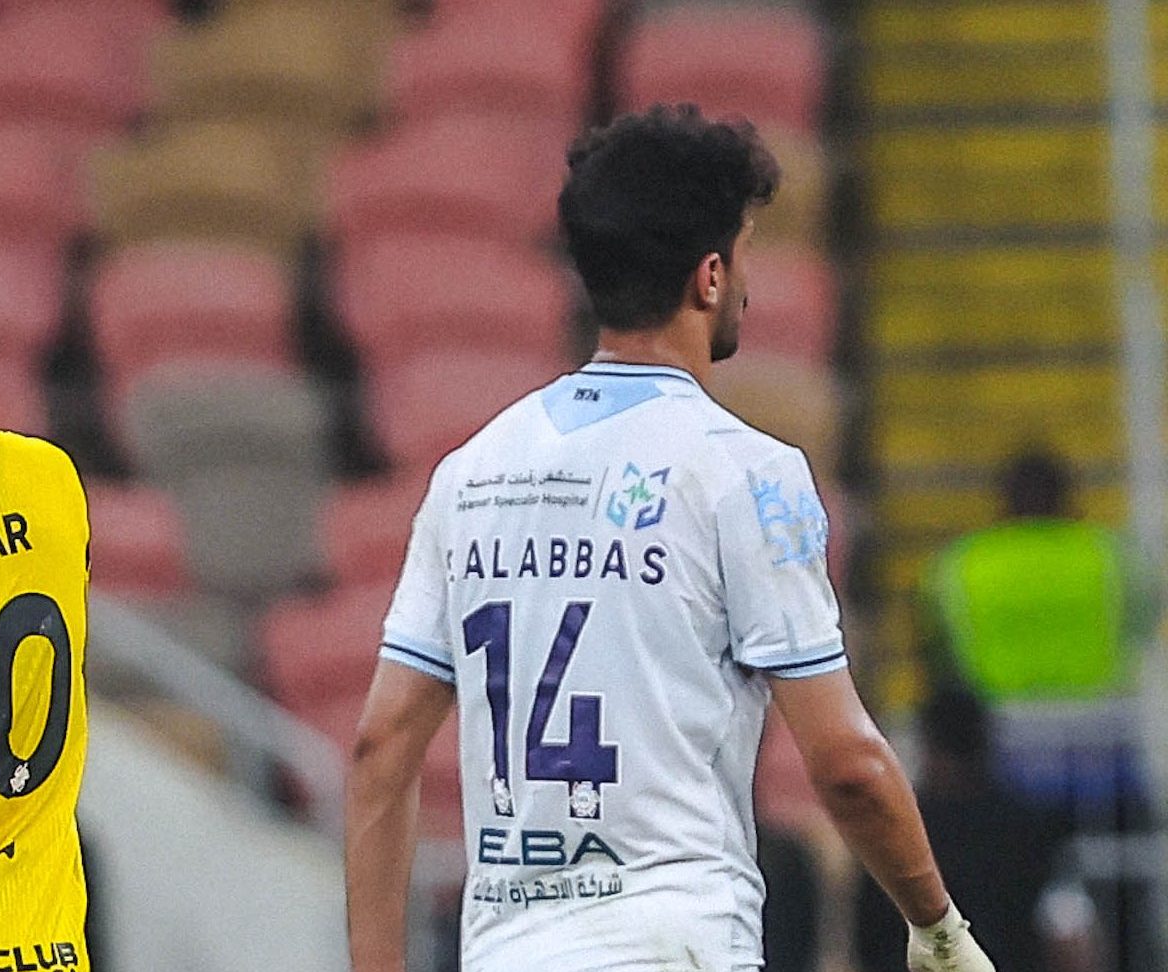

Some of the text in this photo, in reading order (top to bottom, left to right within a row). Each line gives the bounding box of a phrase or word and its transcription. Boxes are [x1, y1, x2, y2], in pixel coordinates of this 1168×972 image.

[461, 536, 668, 585] ALABBAS
[462, 600, 619, 820] 14
[478, 827, 626, 866] EBA
